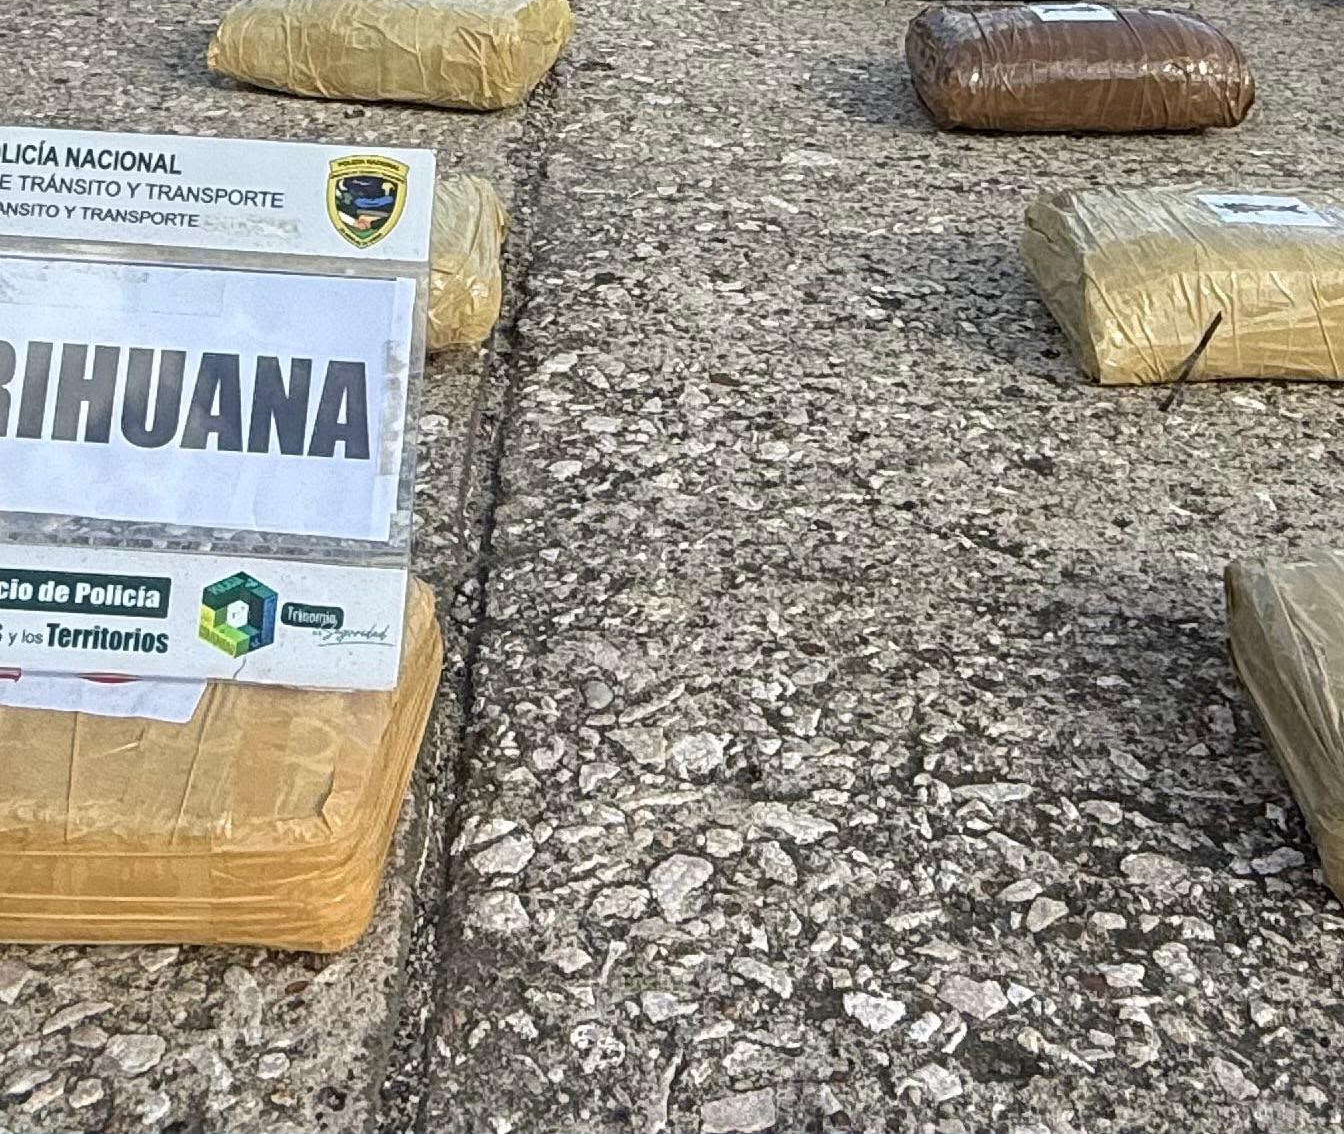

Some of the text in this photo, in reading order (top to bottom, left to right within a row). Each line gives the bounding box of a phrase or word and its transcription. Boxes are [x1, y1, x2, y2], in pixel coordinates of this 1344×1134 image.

[65, 147, 182, 176] NACIONAL
[126, 181, 142, 198] Y
[145, 182, 284, 209] TRANSPORTE
[64, 205, 77, 219] Y
[81, 207, 199, 229] TRANSPORTE
[38, 580, 69, 604] de
[73, 581, 161, 609] Policía
[8, 631, 18, 647] y
[21, 629, 43, 646] los
[46, 622, 169, 654] Territorios
